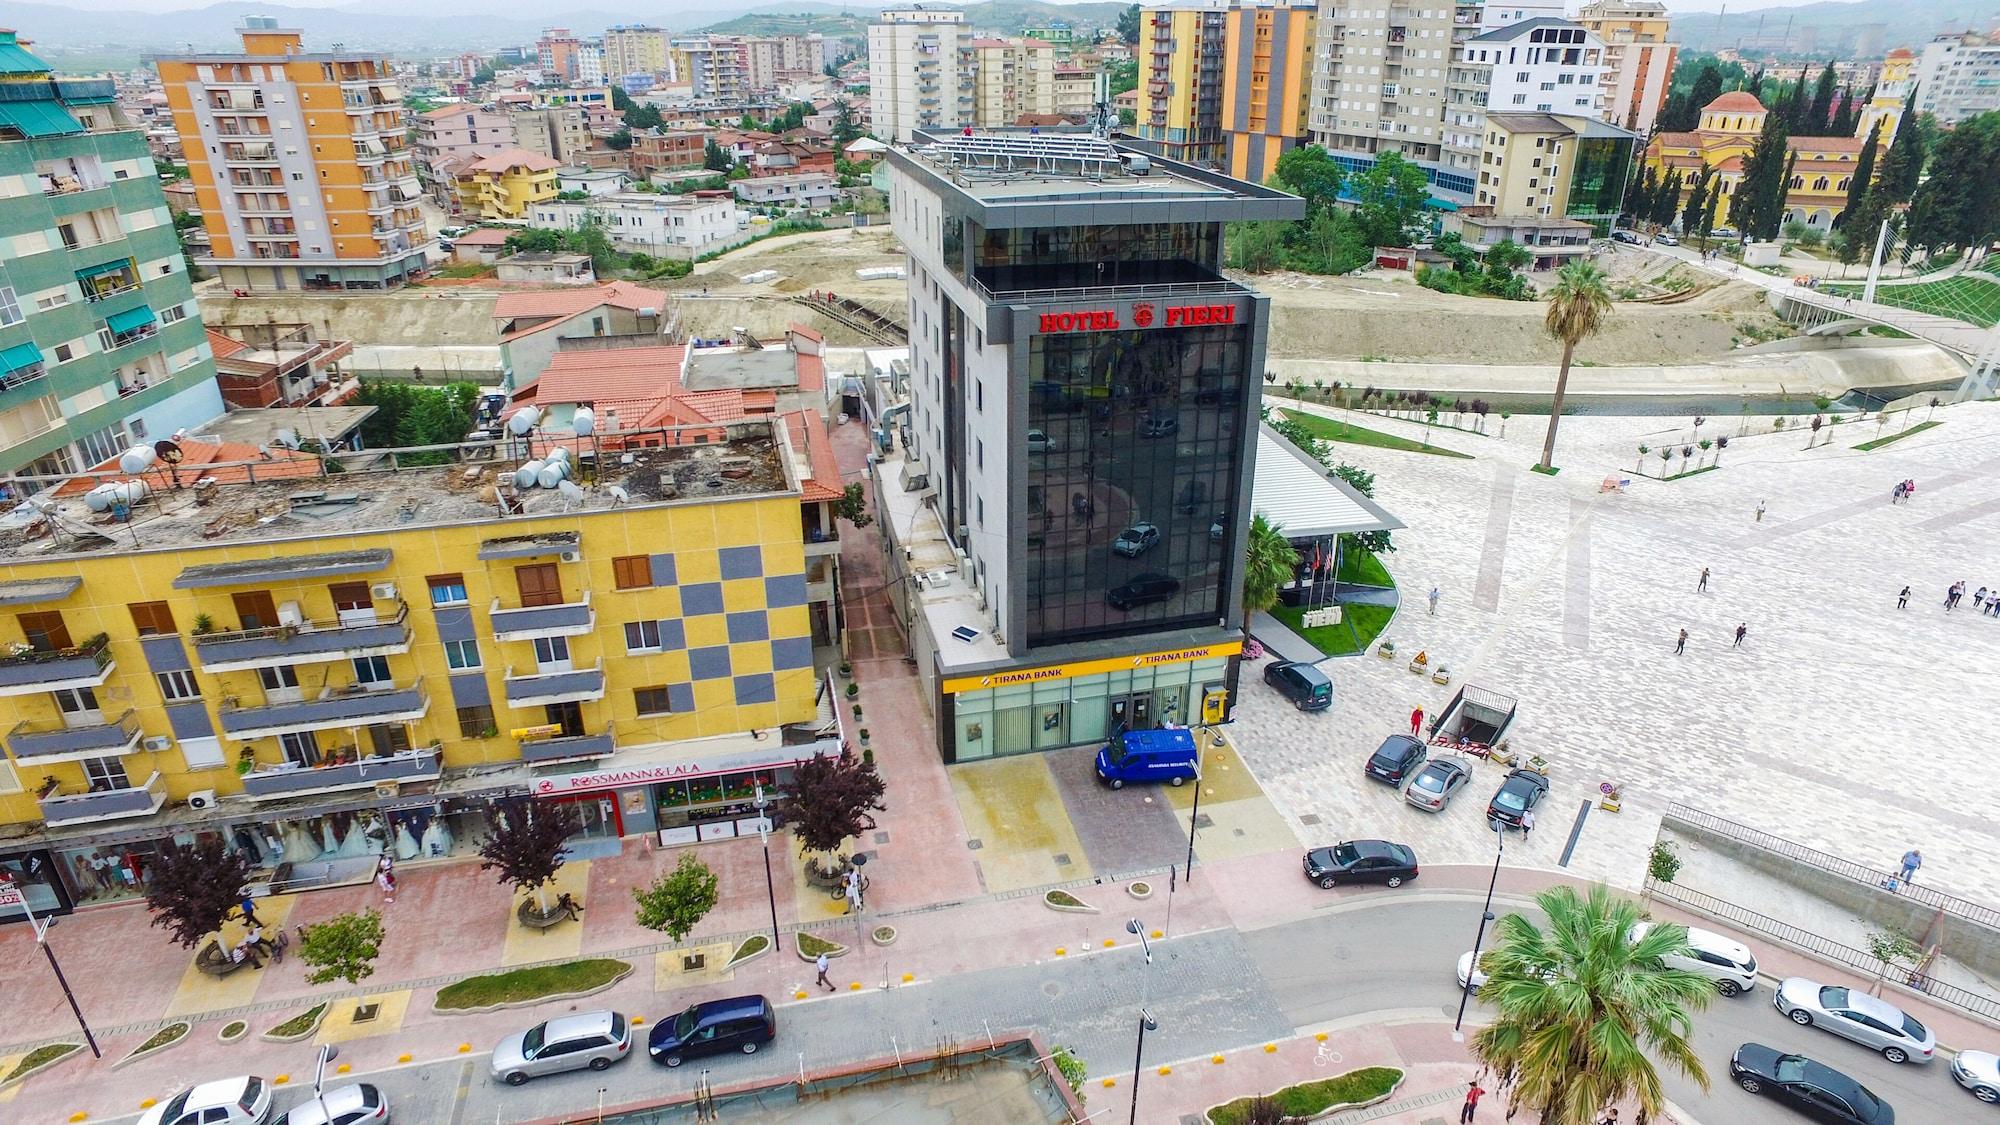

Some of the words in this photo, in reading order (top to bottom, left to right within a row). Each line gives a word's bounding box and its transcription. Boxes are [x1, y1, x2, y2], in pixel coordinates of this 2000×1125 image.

[1039, 311, 1119, 333] HOTEL
[1165, 304, 1235, 326] FIERI
[1146, 653, 1181, 663] TIRANA
[1183, 649, 1209, 659] BANK
[993, 672, 1032, 684] TIRANA
[1034, 669, 1062, 679] BANK
[571, 769, 652, 787] ROSSMANN
[666, 763, 700, 776] LALA
